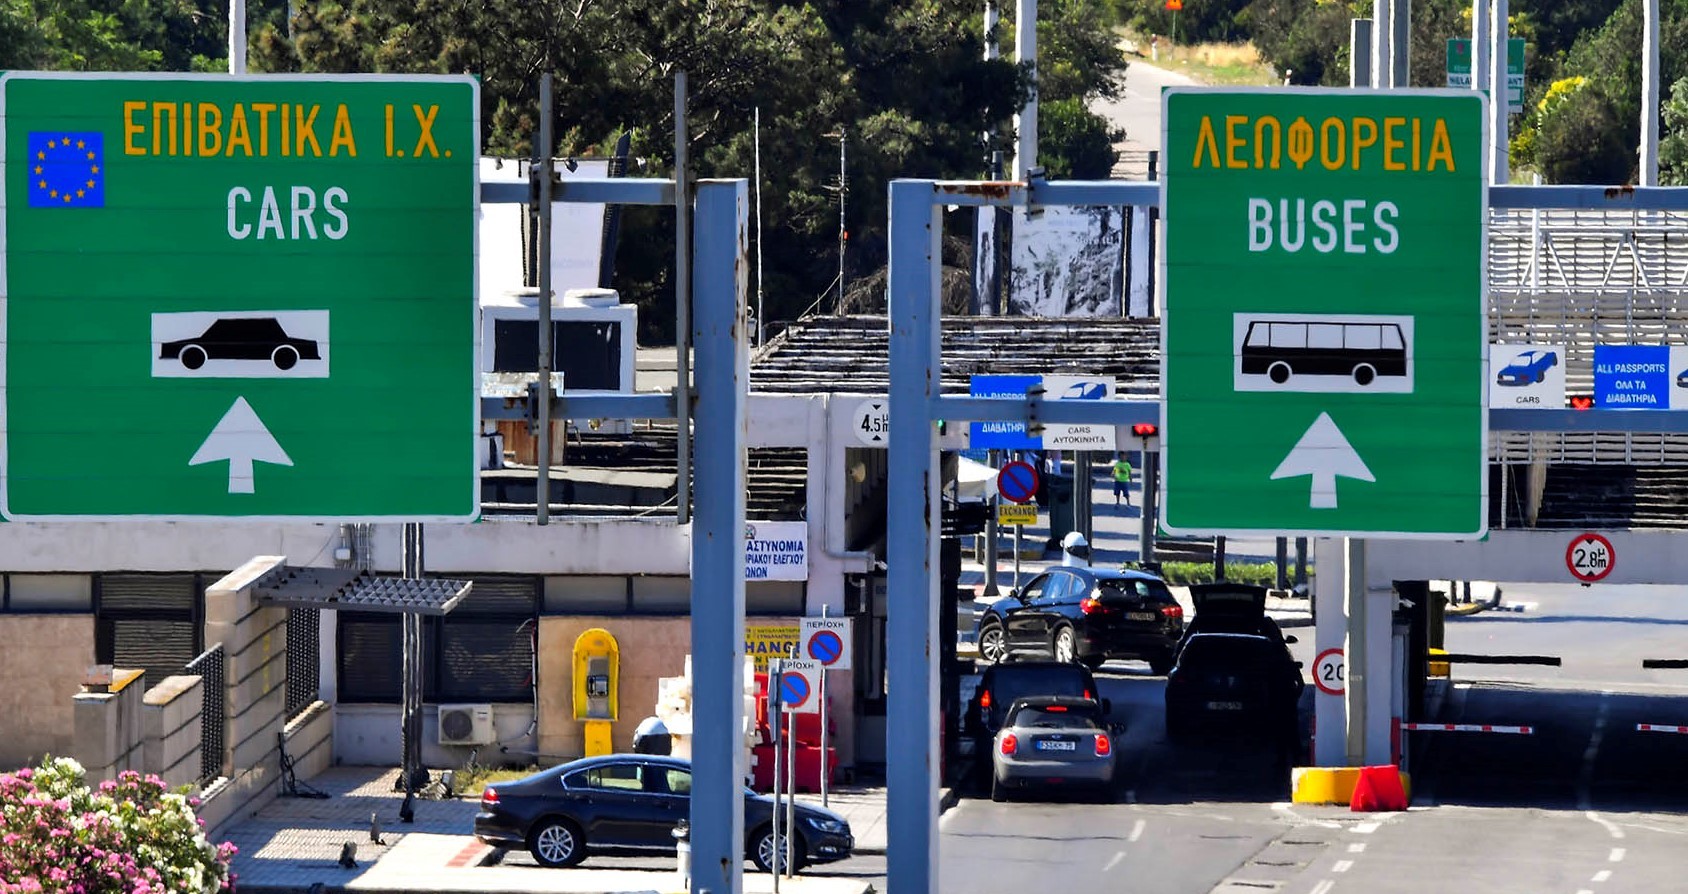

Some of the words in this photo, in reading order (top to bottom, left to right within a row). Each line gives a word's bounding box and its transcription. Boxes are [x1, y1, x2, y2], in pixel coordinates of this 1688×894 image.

[123, 101, 357, 157] ΕΠΙΒΑΤΙΚΑ
[1192, 115, 1456, 172] ΛΕΩΦΟΡΕΙΑ
[227, 185, 349, 240] CARS
[1248, 197, 1400, 254] BUSES
[1597, 364, 1612, 373] ALL
[1615, 363, 1666, 373] PASSPORTS
[1635, 380, 1646, 390] ΤΑ
[1515, 396, 1540, 404] CARS
[1606, 393, 1657, 404] ΔΙΑΒΑΤΗΡΙΑ
[861, 414, 881, 432] 4.5
[1068, 426, 1091, 435] CARS
[1053, 436, 1106, 444] ΑΥΤΟΚΙΝΗΤΑ
[746, 540, 804, 552] ΑΣΤΥΝΟΜΙΑ
[745, 554, 772, 564] ΡΙΑΚΟΥ
[1575, 548, 1597, 568] 2.8
[745, 567, 768, 578] ΩΝΩΝ
[745, 641, 800, 653] HANG
[1324, 663, 1344, 681] 20
